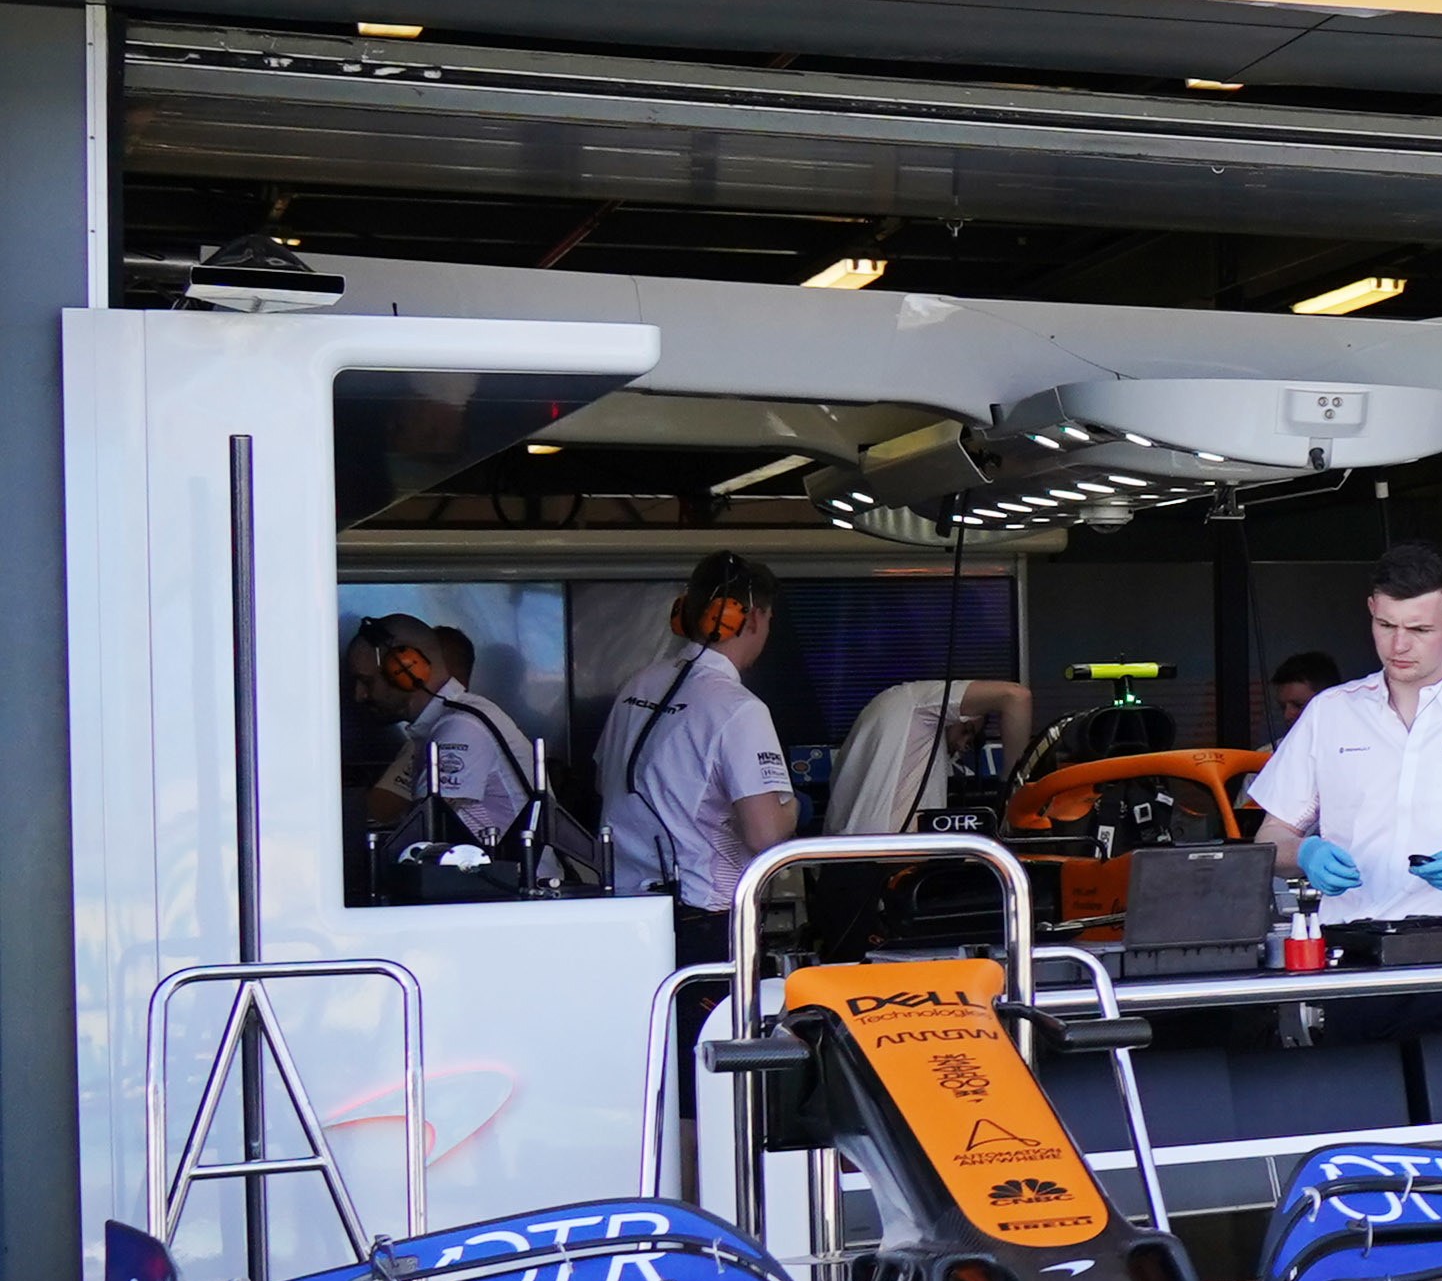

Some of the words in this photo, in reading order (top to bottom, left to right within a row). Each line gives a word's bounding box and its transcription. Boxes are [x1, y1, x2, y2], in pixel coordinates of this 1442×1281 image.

[622, 696, 677, 715] McLan
[845, 991, 988, 1016] DELL
[876, 1028, 998, 1049] ARROW
[953, 1148, 1063, 1163] AUTOMATION
[958, 1152, 1063, 1167] ANYWHERE
[989, 1193, 1075, 1207] CNBC
[997, 1216, 1094, 1232] PIRELLI
